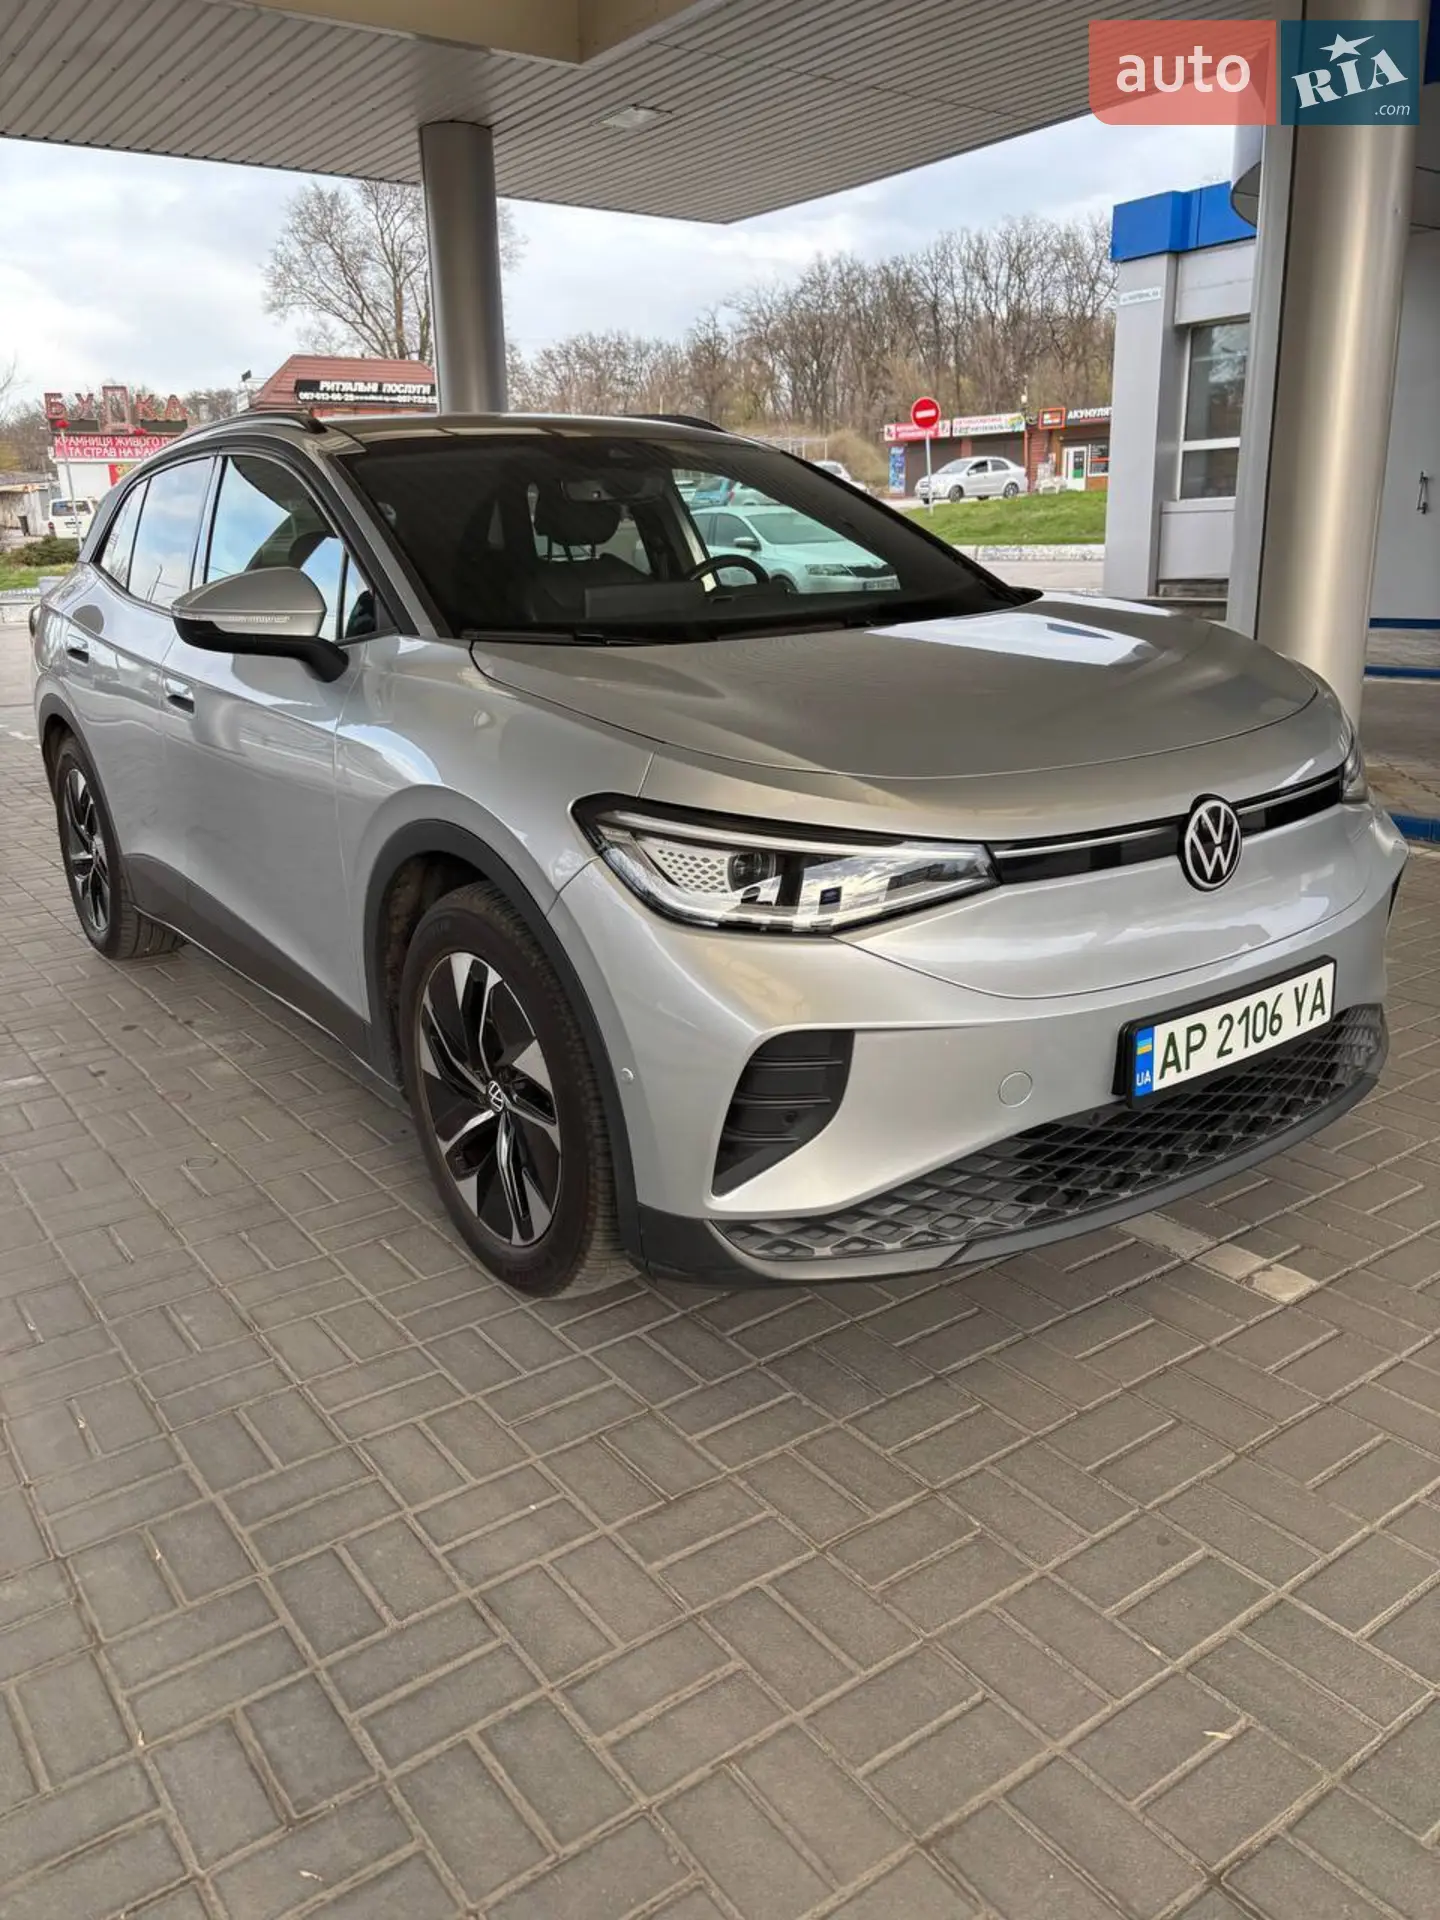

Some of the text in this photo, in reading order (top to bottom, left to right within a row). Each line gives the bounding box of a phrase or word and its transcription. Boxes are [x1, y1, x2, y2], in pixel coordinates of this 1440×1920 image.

[320, 380, 431, 394] РИТУАЛЬНІ ПОСЛУГИ
[69, 447, 82, 457] ТА
[84, 447, 116, 457] СТРАВ
[119, 447, 135, 457] НА
[1159, 977, 1327, 1080] AP 2106 YA
[1136, 1071, 1152, 1087] UA
